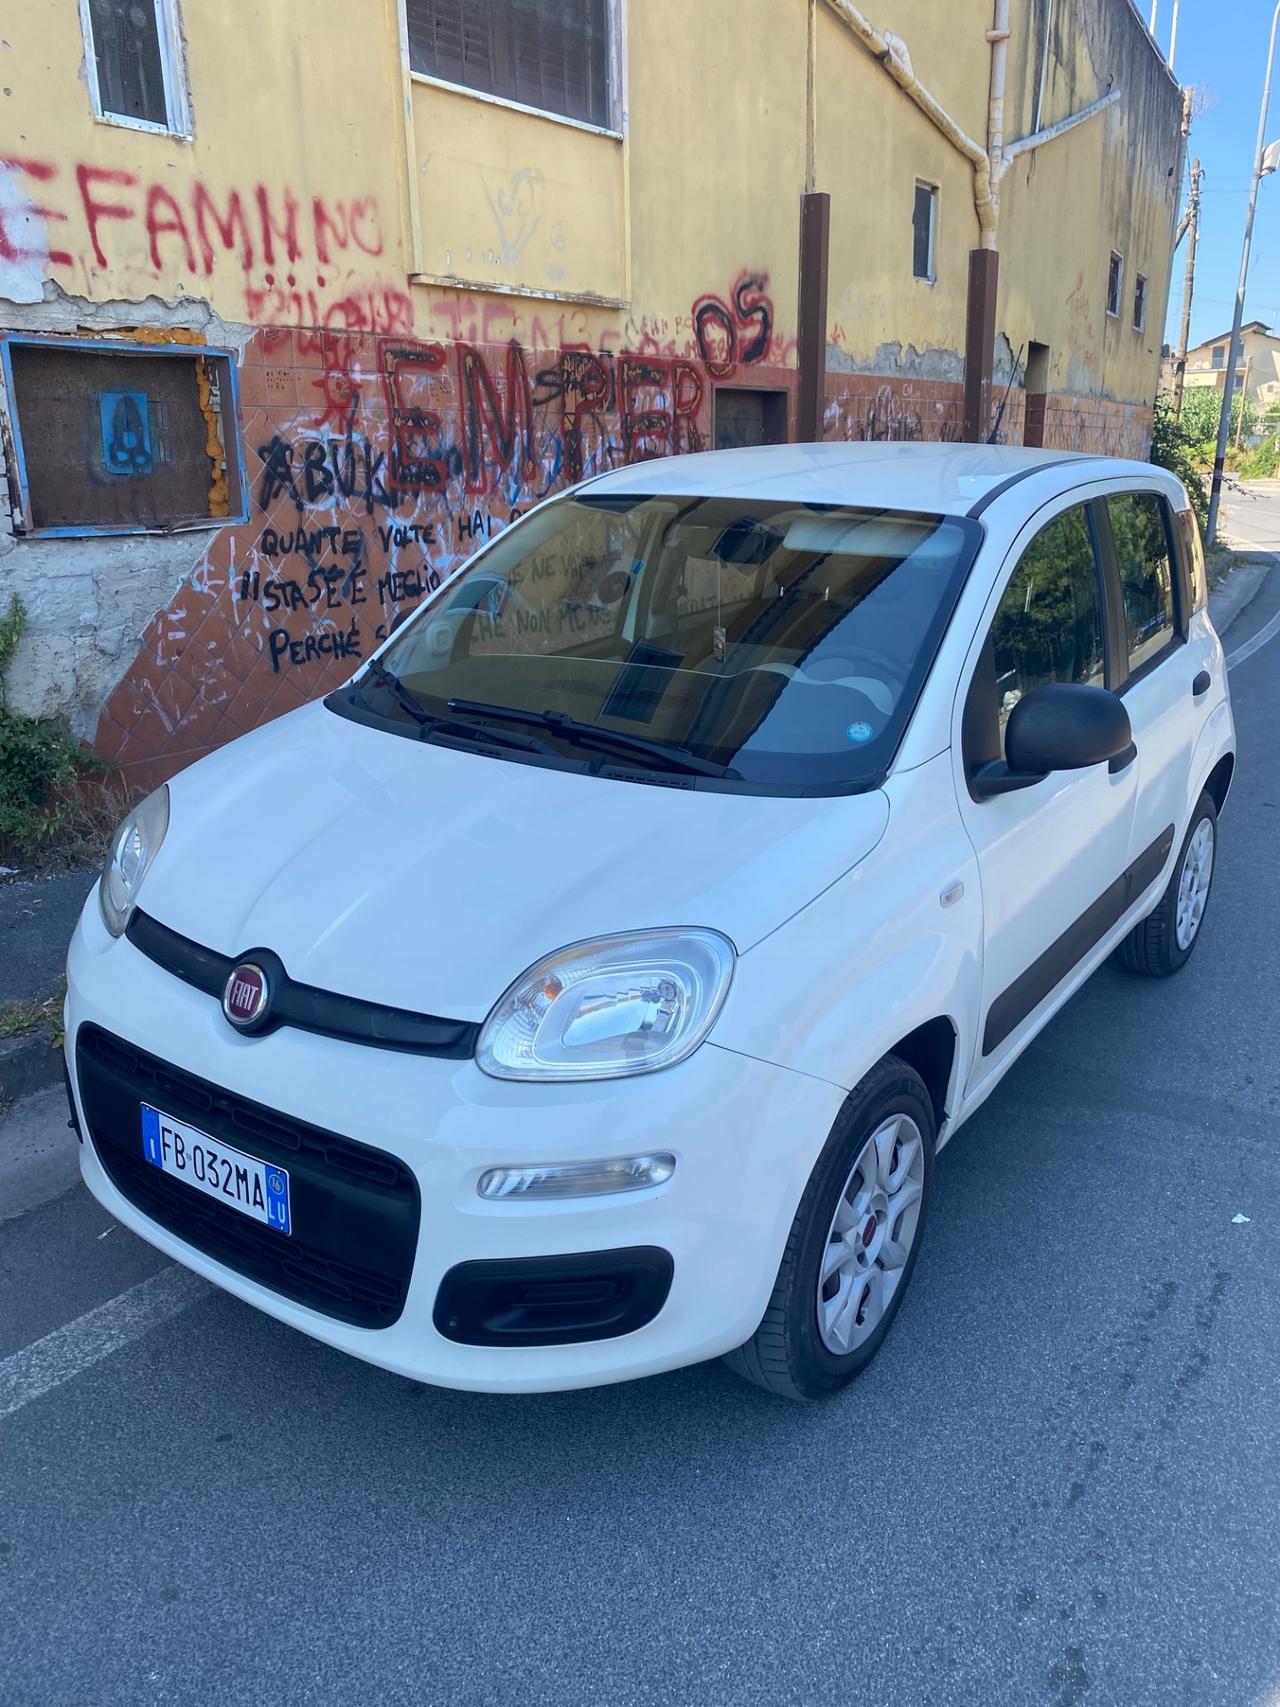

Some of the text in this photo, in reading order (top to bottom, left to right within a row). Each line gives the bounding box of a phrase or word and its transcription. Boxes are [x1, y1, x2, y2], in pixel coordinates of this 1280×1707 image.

[261, 527, 359, 558] QUANTE
[378, 523, 437, 554] VOLTE
[457, 509, 492, 542] HAI
[378, 564, 441, 606] MEGLIO
[231, 979, 259, 1011] FIAT
[268, 1196, 286, 1224] LU
